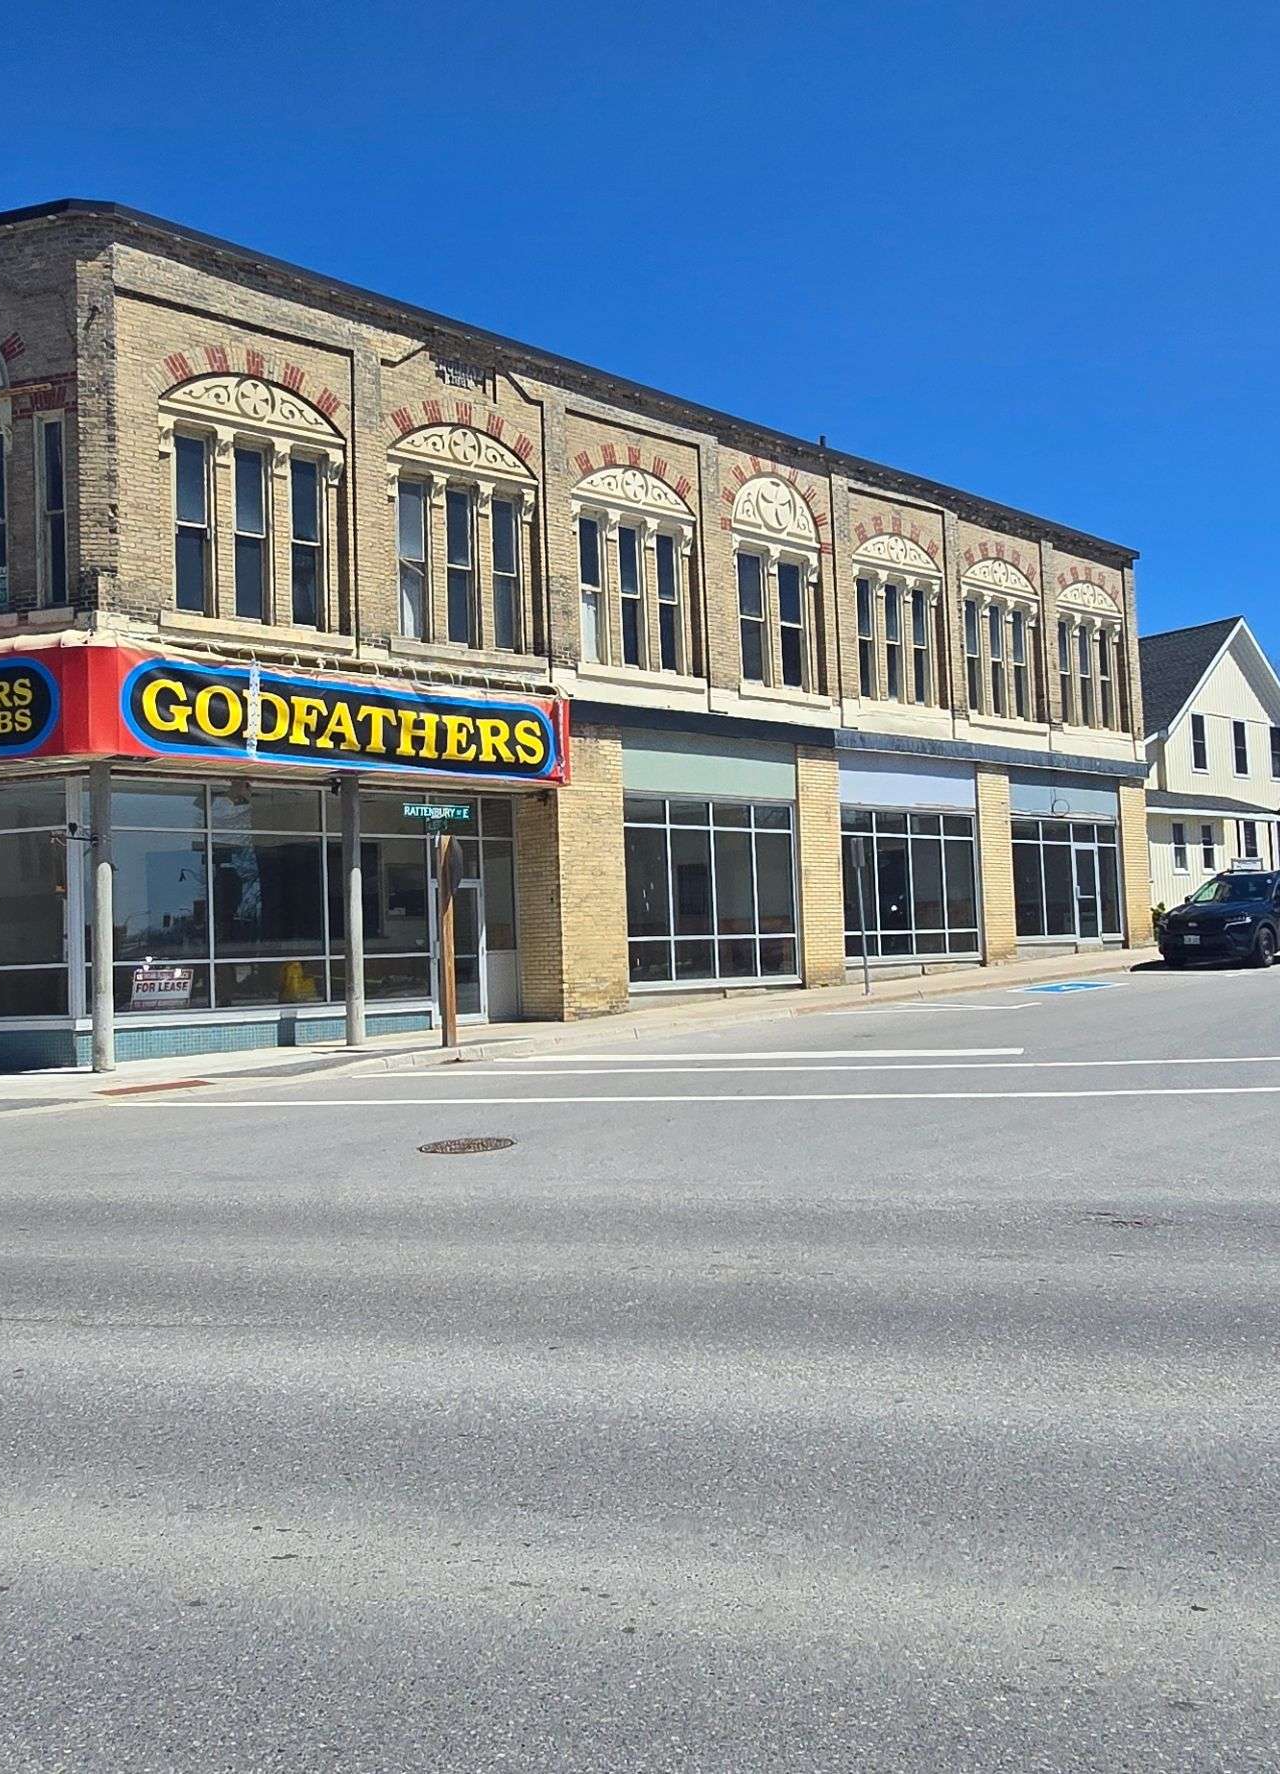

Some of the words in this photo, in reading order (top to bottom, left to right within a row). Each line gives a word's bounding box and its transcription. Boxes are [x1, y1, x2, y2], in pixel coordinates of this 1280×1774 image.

[141, 678, 547, 765] GODFATHERS
[404, 806, 455, 818] RATTENBURY
[462, 808, 469, 818] E
[136, 982, 156, 993] FOR
[158, 981, 189, 992] LEASE
